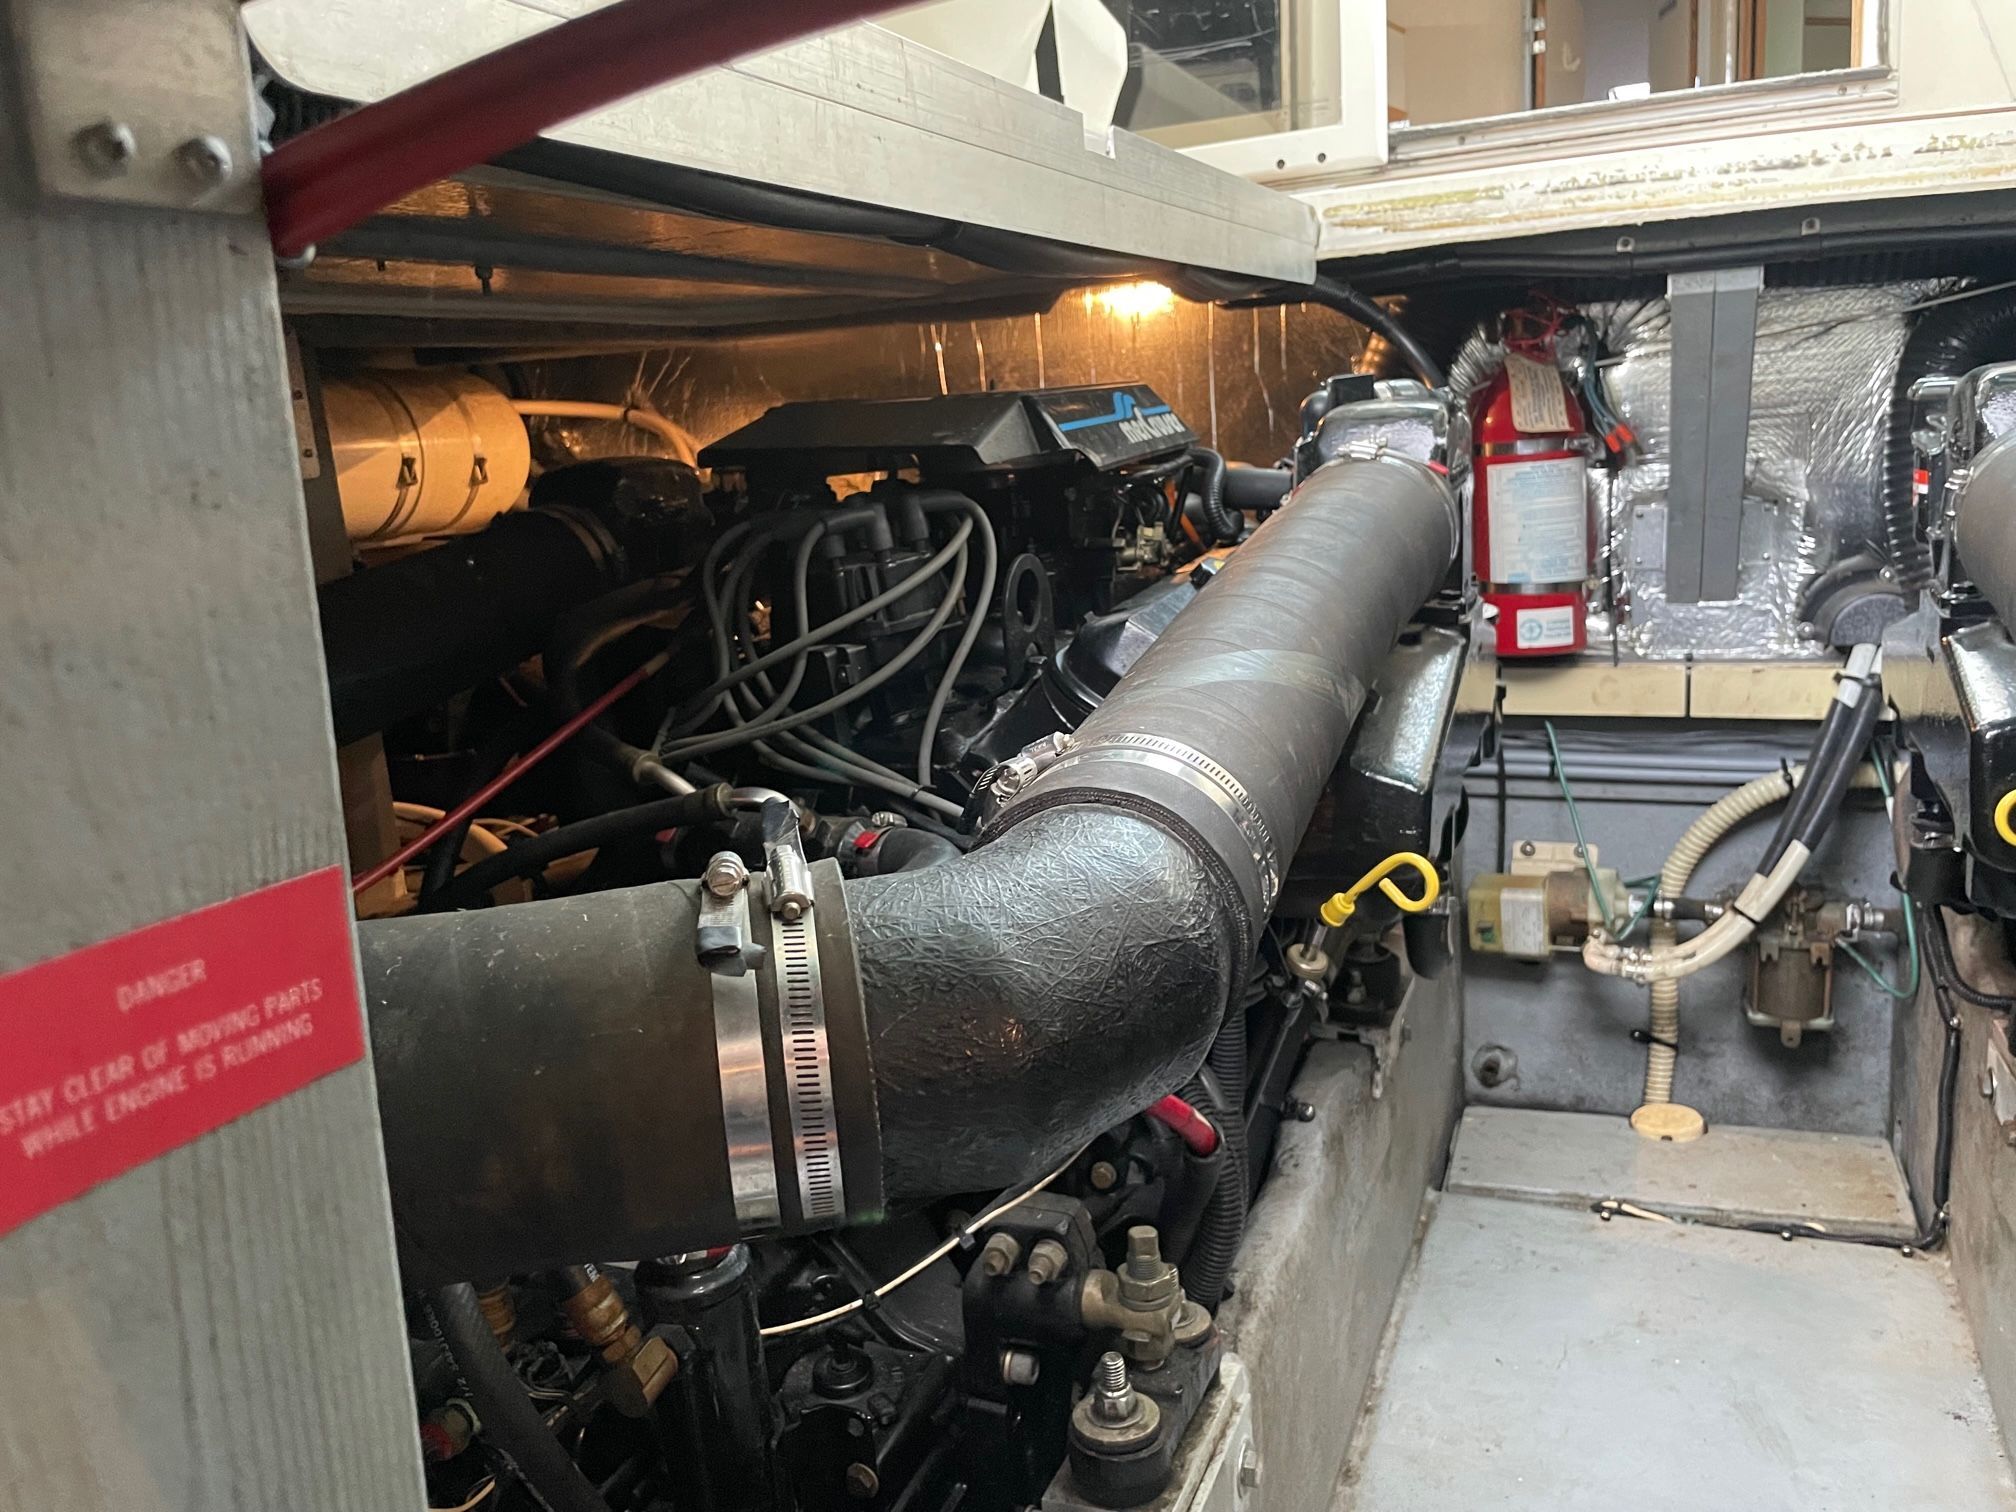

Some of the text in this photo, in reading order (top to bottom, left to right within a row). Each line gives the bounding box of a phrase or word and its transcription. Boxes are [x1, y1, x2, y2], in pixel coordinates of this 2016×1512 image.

[0, 978, 323, 1135] STAY CLEAR OF MOVING PARTS
[116, 958, 206, 1013] DANGER
[20, 1013, 313, 1160] WHILE ENGINE IS RUNNING
